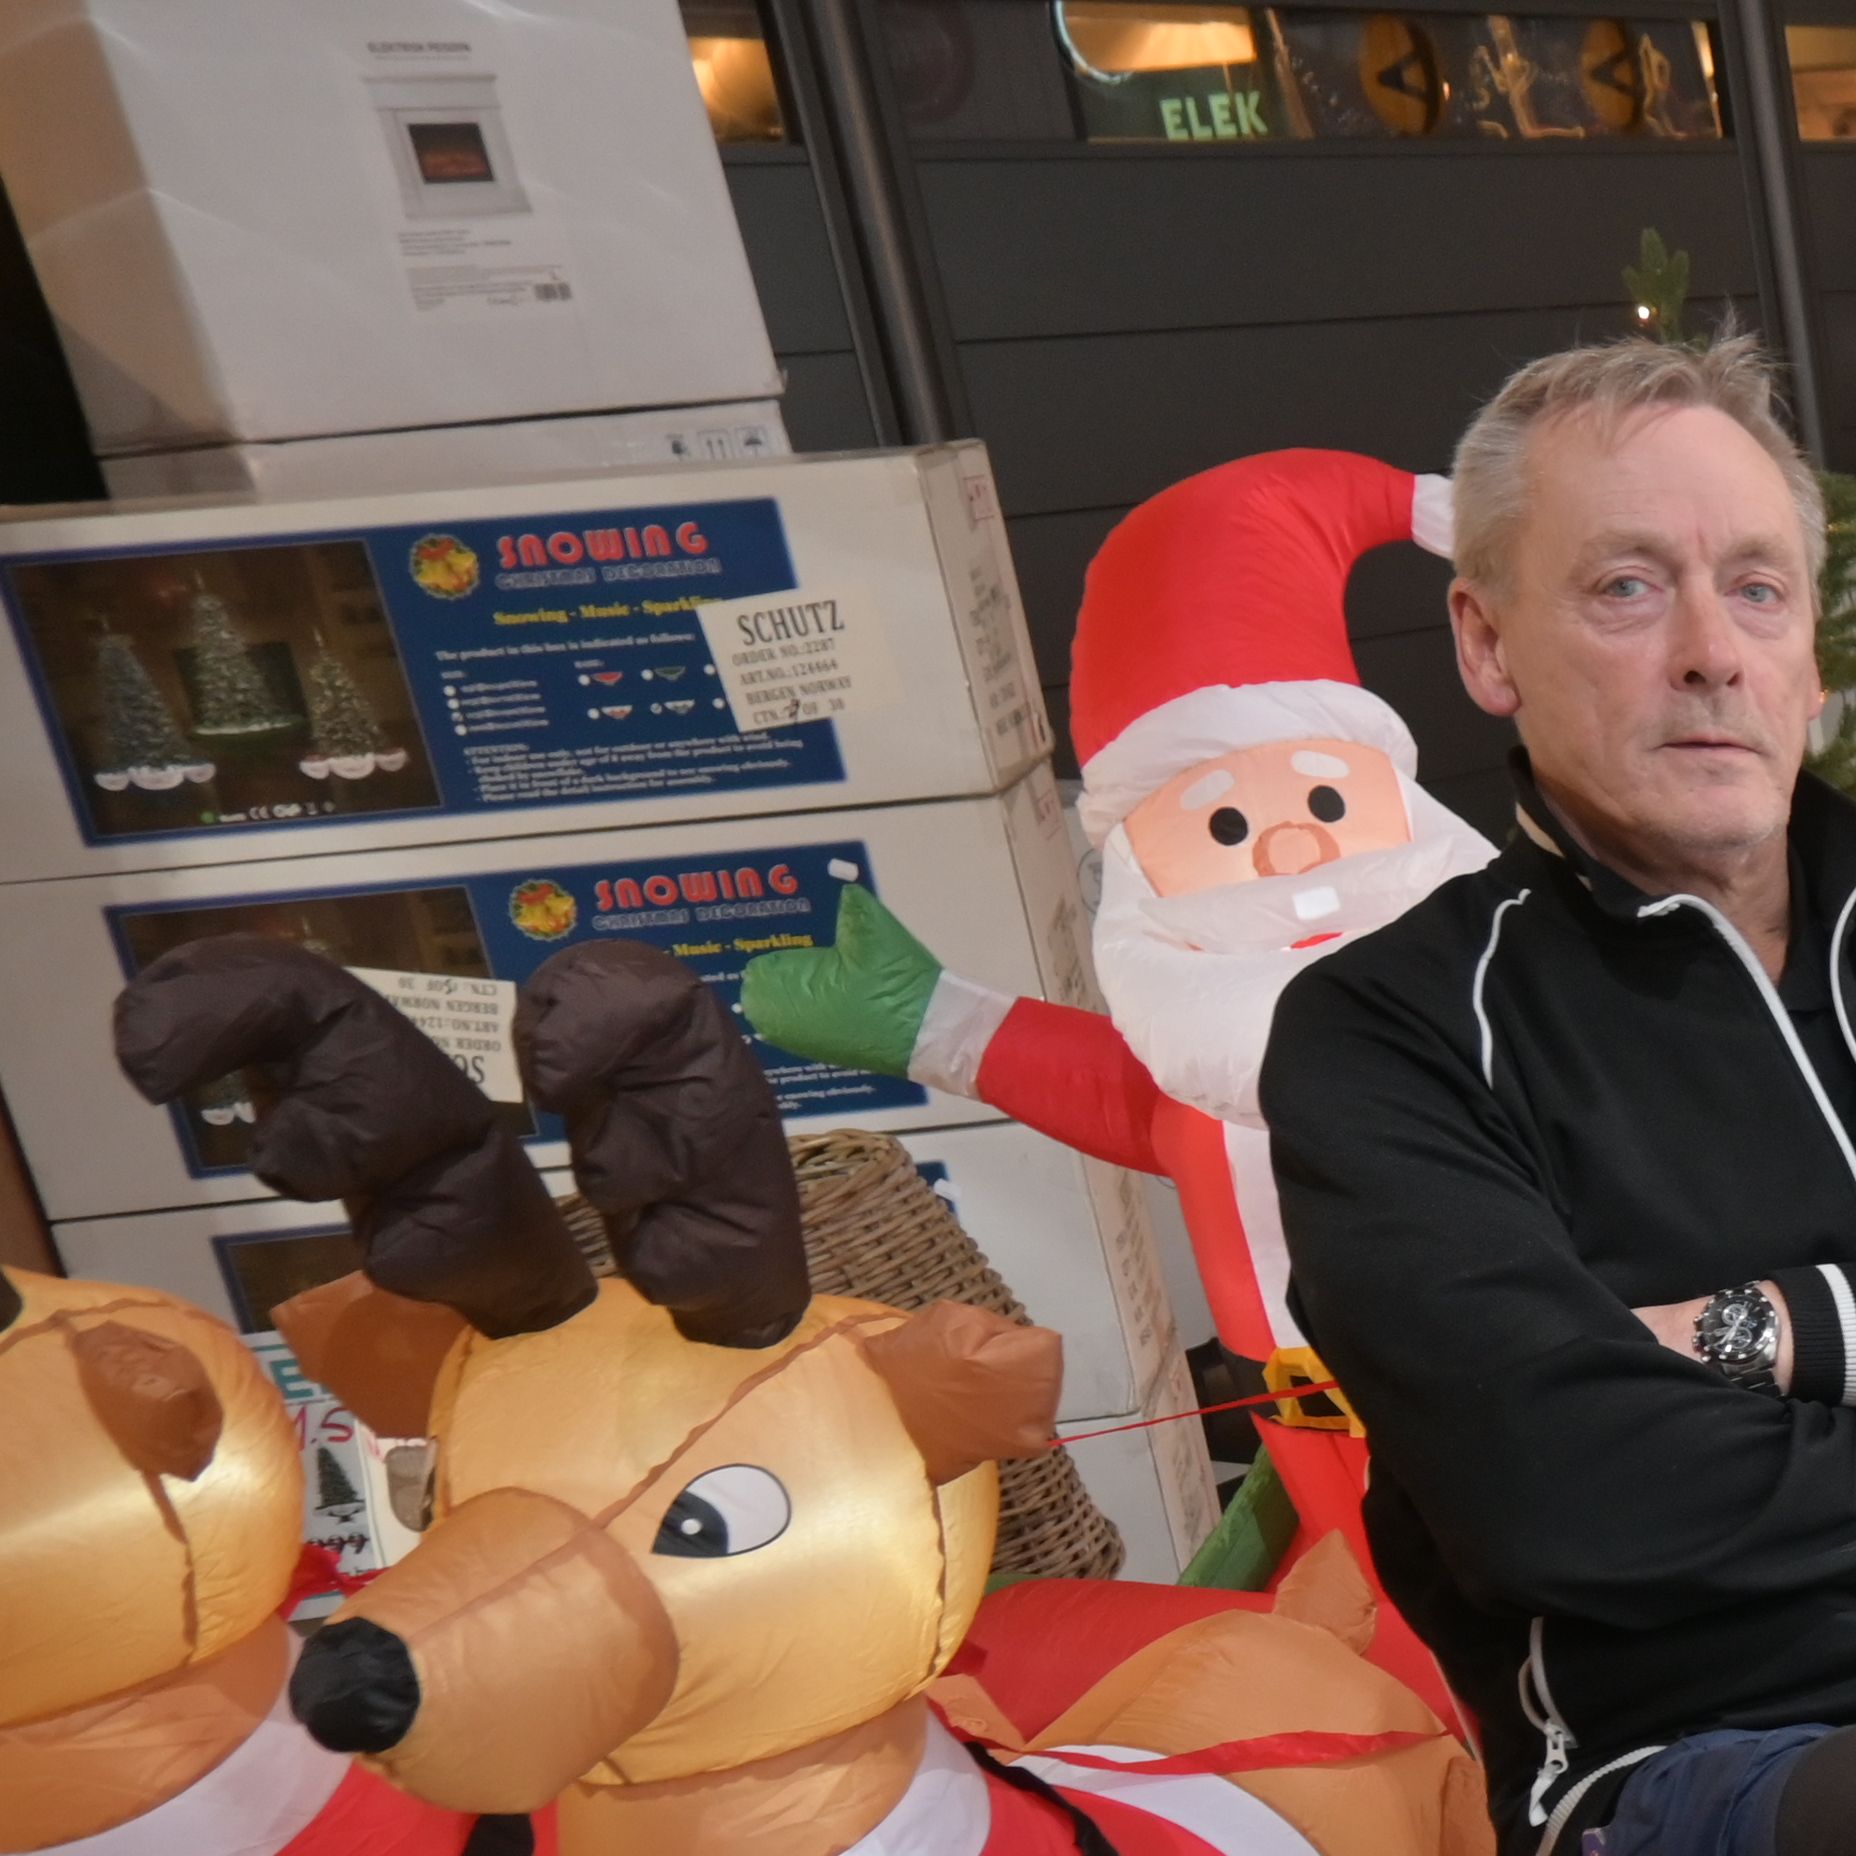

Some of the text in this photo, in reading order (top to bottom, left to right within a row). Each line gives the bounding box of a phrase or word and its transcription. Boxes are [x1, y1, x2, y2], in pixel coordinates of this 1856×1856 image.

[1160, 90, 1268, 142] ELEK
[496, 521, 709, 569] SNOWING
[601, 557, 723, 582] DECORATION
[493, 608, 570, 625] Snowing
[578, 601, 630, 618] Music
[737, 600, 845, 646] SCHUTZ
[732, 648, 776, 666] ORDER
[746, 675, 852, 705] BERGEN NORWAY
[594, 863, 799, 912] SNOWING
[696, 898, 812, 922] DECORATION
[672, 934, 815, 957] Music Sparkling
